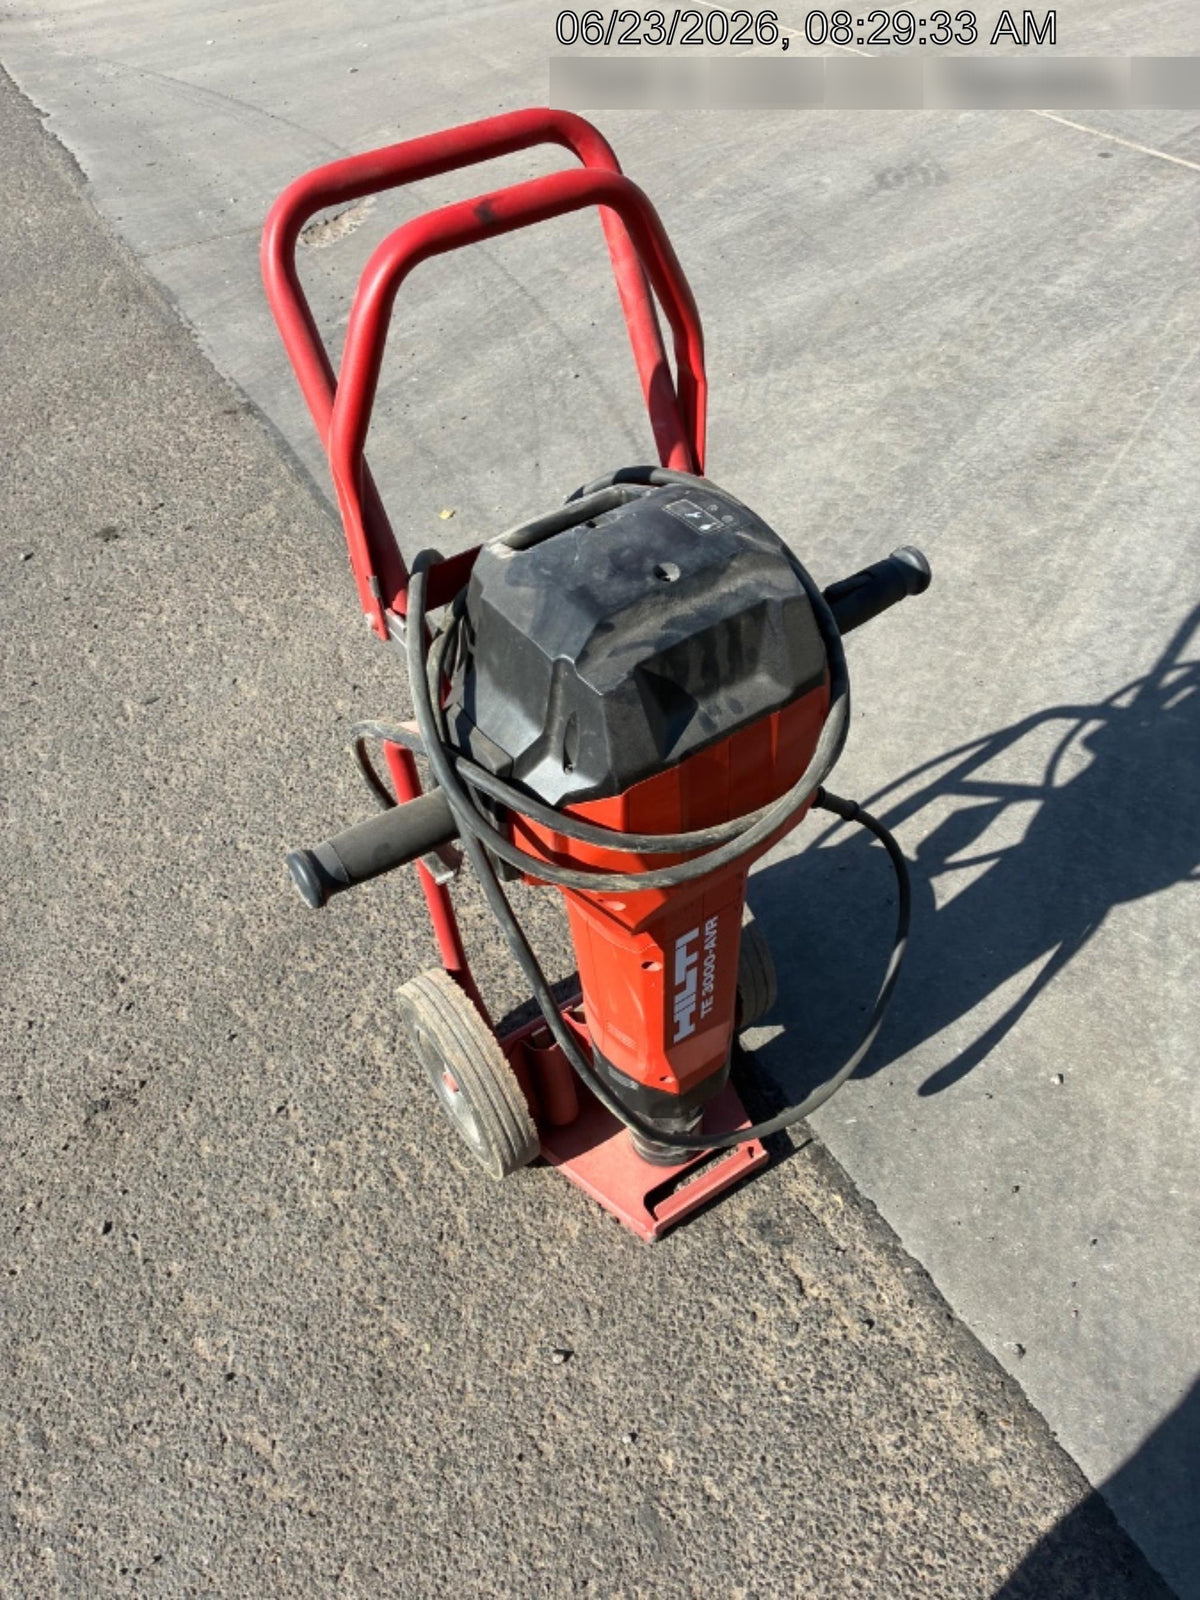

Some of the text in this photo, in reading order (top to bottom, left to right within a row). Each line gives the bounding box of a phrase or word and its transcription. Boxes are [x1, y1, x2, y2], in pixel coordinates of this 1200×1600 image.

[673, 928, 699, 1044] HILTI
[700, 915, 719, 1019] TE 3000-AVR
